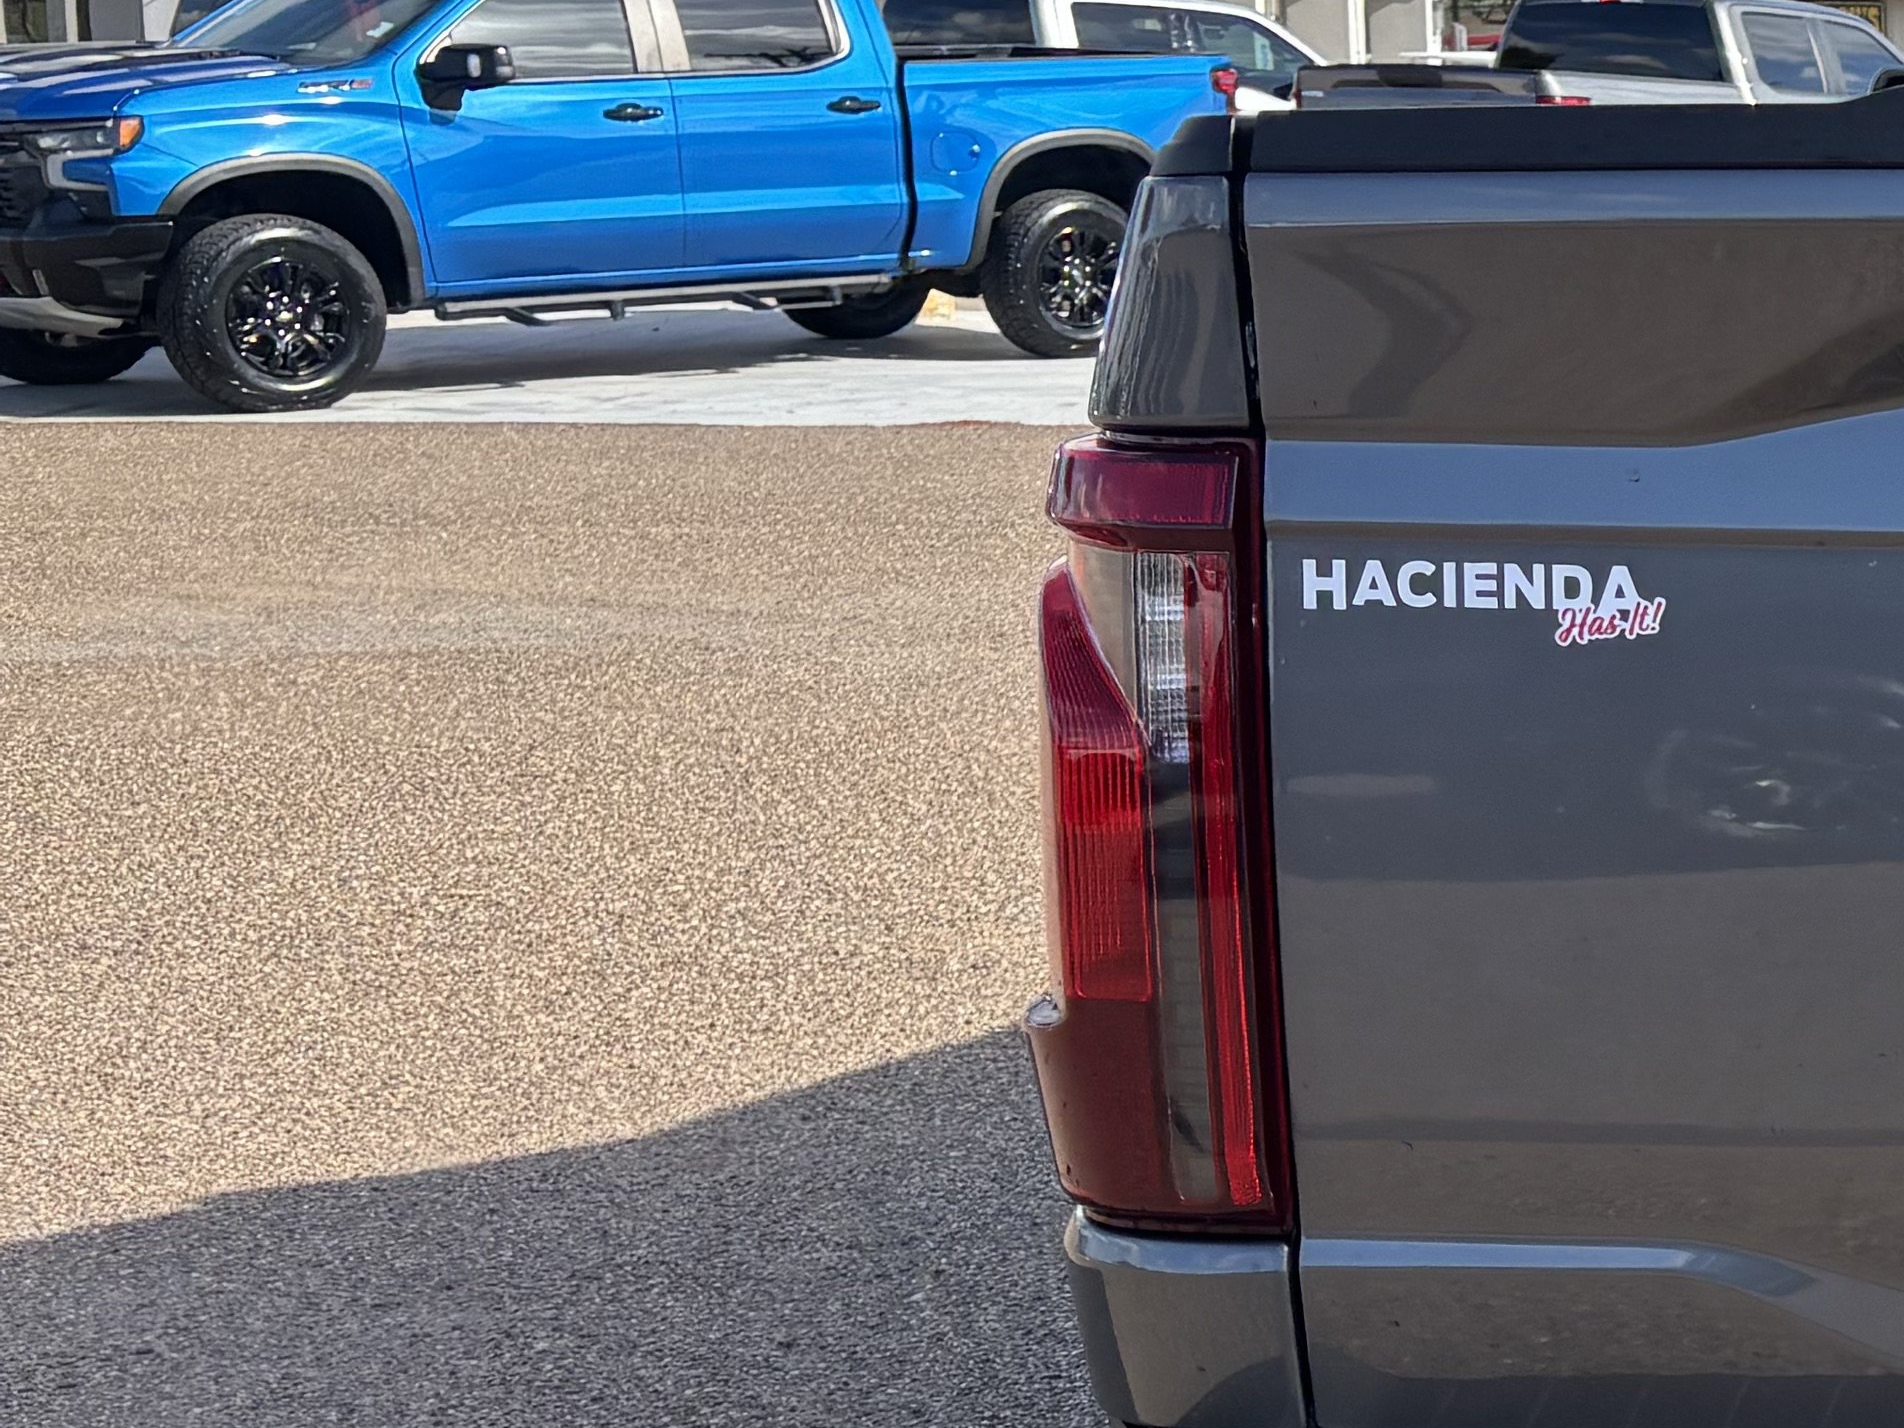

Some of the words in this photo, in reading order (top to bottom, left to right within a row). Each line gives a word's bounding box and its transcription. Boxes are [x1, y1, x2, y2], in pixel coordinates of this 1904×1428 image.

[1302, 558, 1643, 613] HACIENDA
[1557, 604, 1621, 644] Has
[1626, 599, 1664, 638] It!
